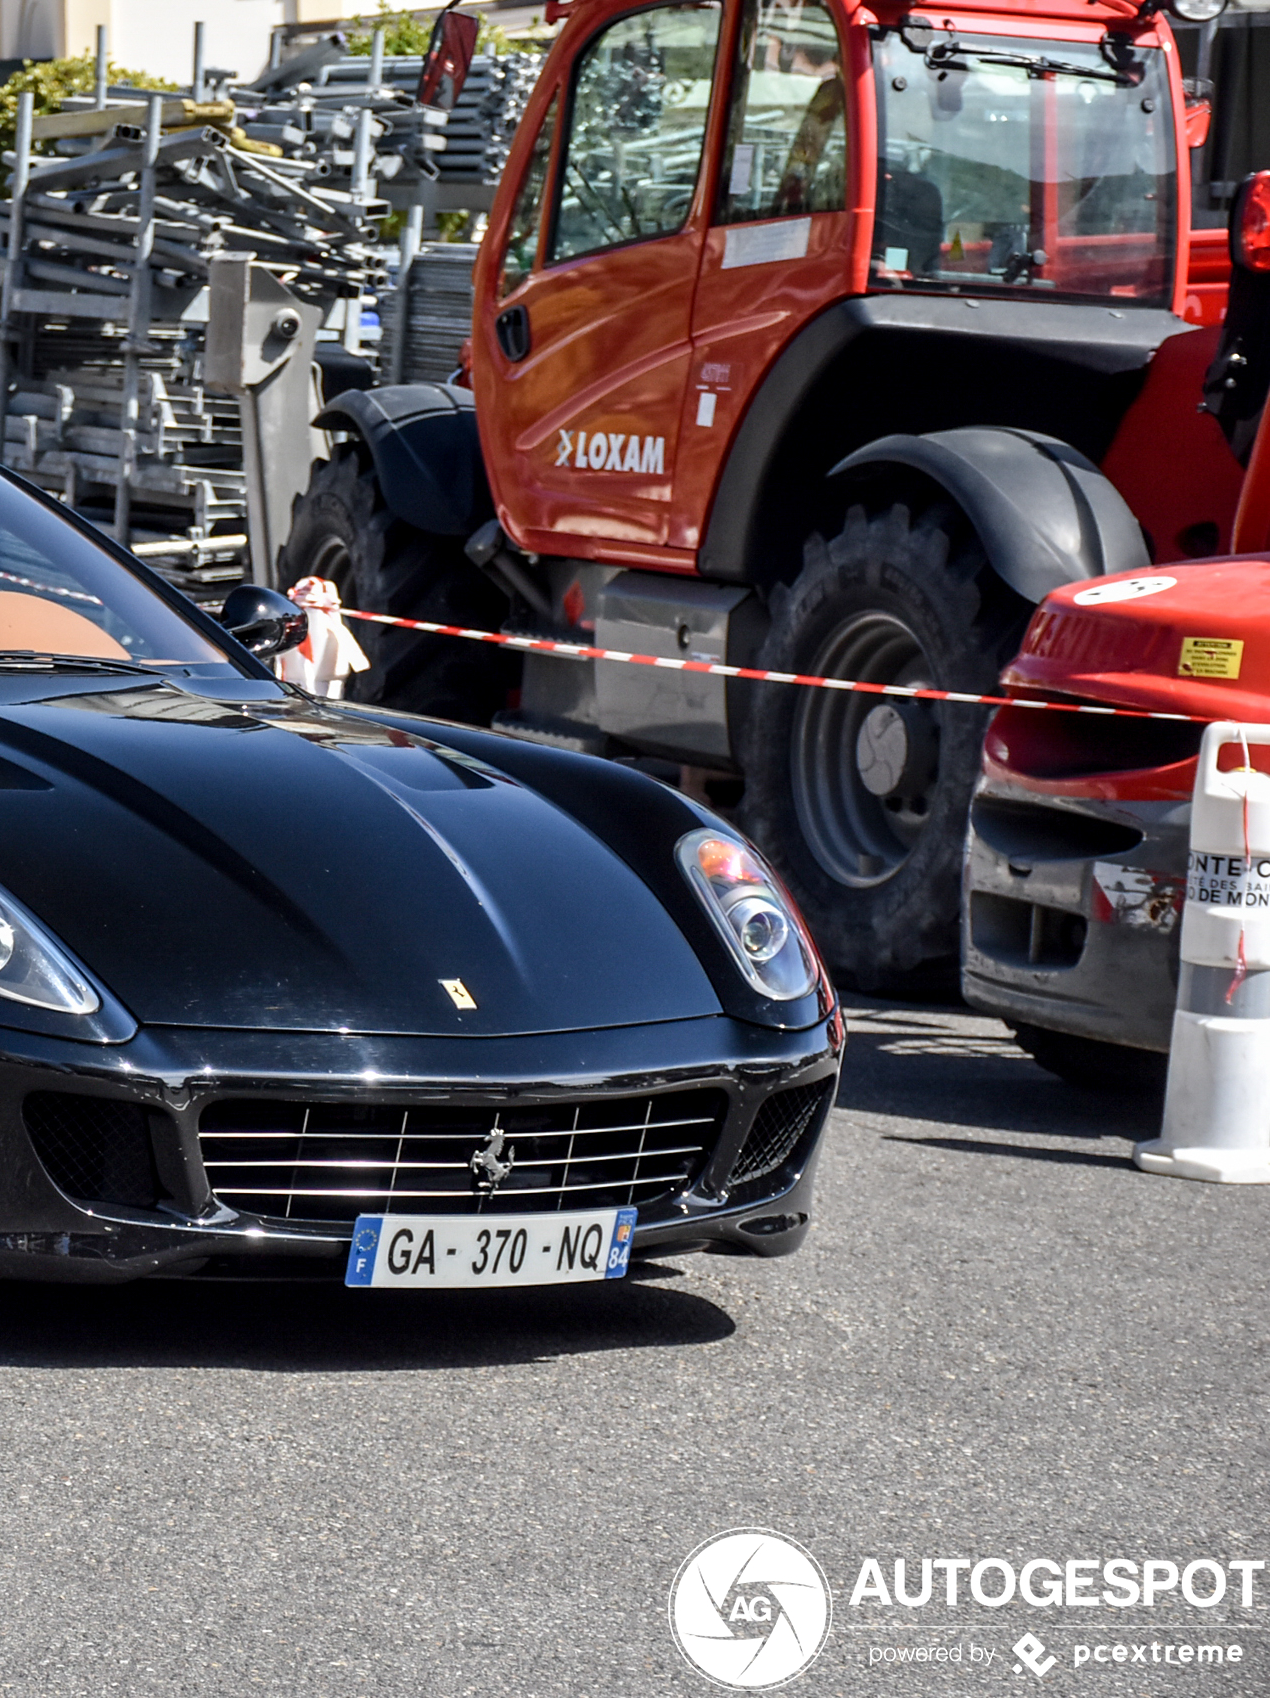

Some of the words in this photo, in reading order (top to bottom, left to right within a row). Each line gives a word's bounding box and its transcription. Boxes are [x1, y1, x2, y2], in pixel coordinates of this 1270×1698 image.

[575, 431, 665, 475] LOXAM
[1210, 879, 1238, 891] DES
[1199, 888, 1222, 904] DE
[356, 1258, 367, 1274] F
[608, 1248, 629, 1269] 84
